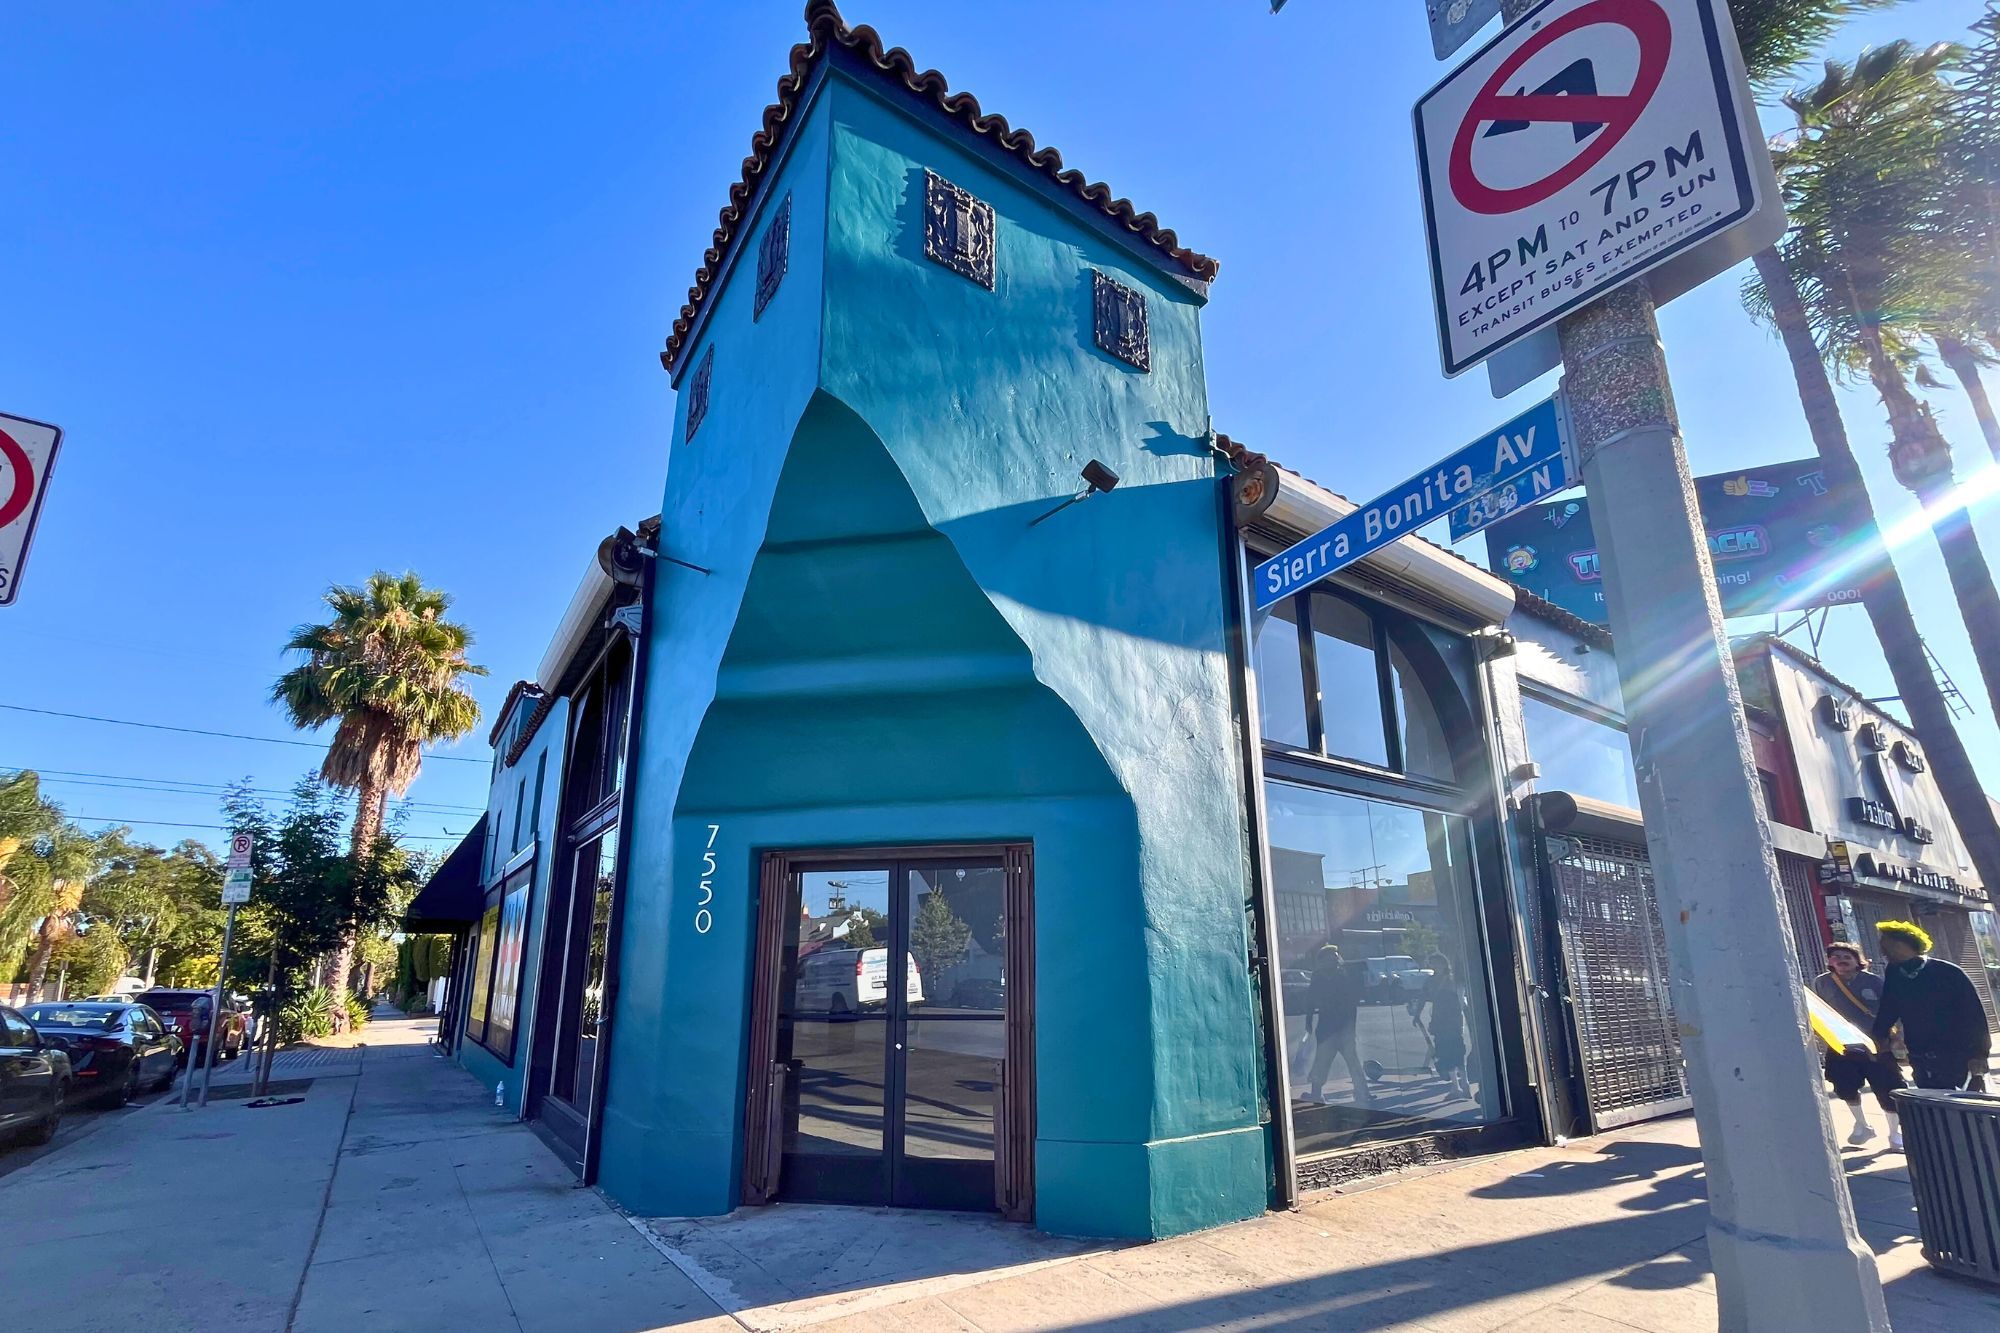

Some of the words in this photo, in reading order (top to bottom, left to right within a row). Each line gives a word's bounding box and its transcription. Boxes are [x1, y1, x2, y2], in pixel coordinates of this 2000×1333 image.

[1458, 270, 1536, 326] EXCEPT
[1546, 240, 1588, 275] SAT
[1598, 207, 1649, 245] AND
[1660, 167, 1715, 208] SUN
[1460, 224, 1548, 296] 4PM
[1558, 211, 1579, 230] TO
[1590, 129, 1704, 216] 7PM
[1472, 296, 1534, 337] TRANSIT
[1541, 262, 1596, 299] BUSES
[1602, 203, 1702, 264] EXEMPTED
[1267, 532, 1349, 593] Sierra
[1364, 464, 1473, 543] Bonita
[1494, 426, 1536, 474] Av
[1532, 465, 1551, 495] N
[695, 824, 720, 934] 7550
